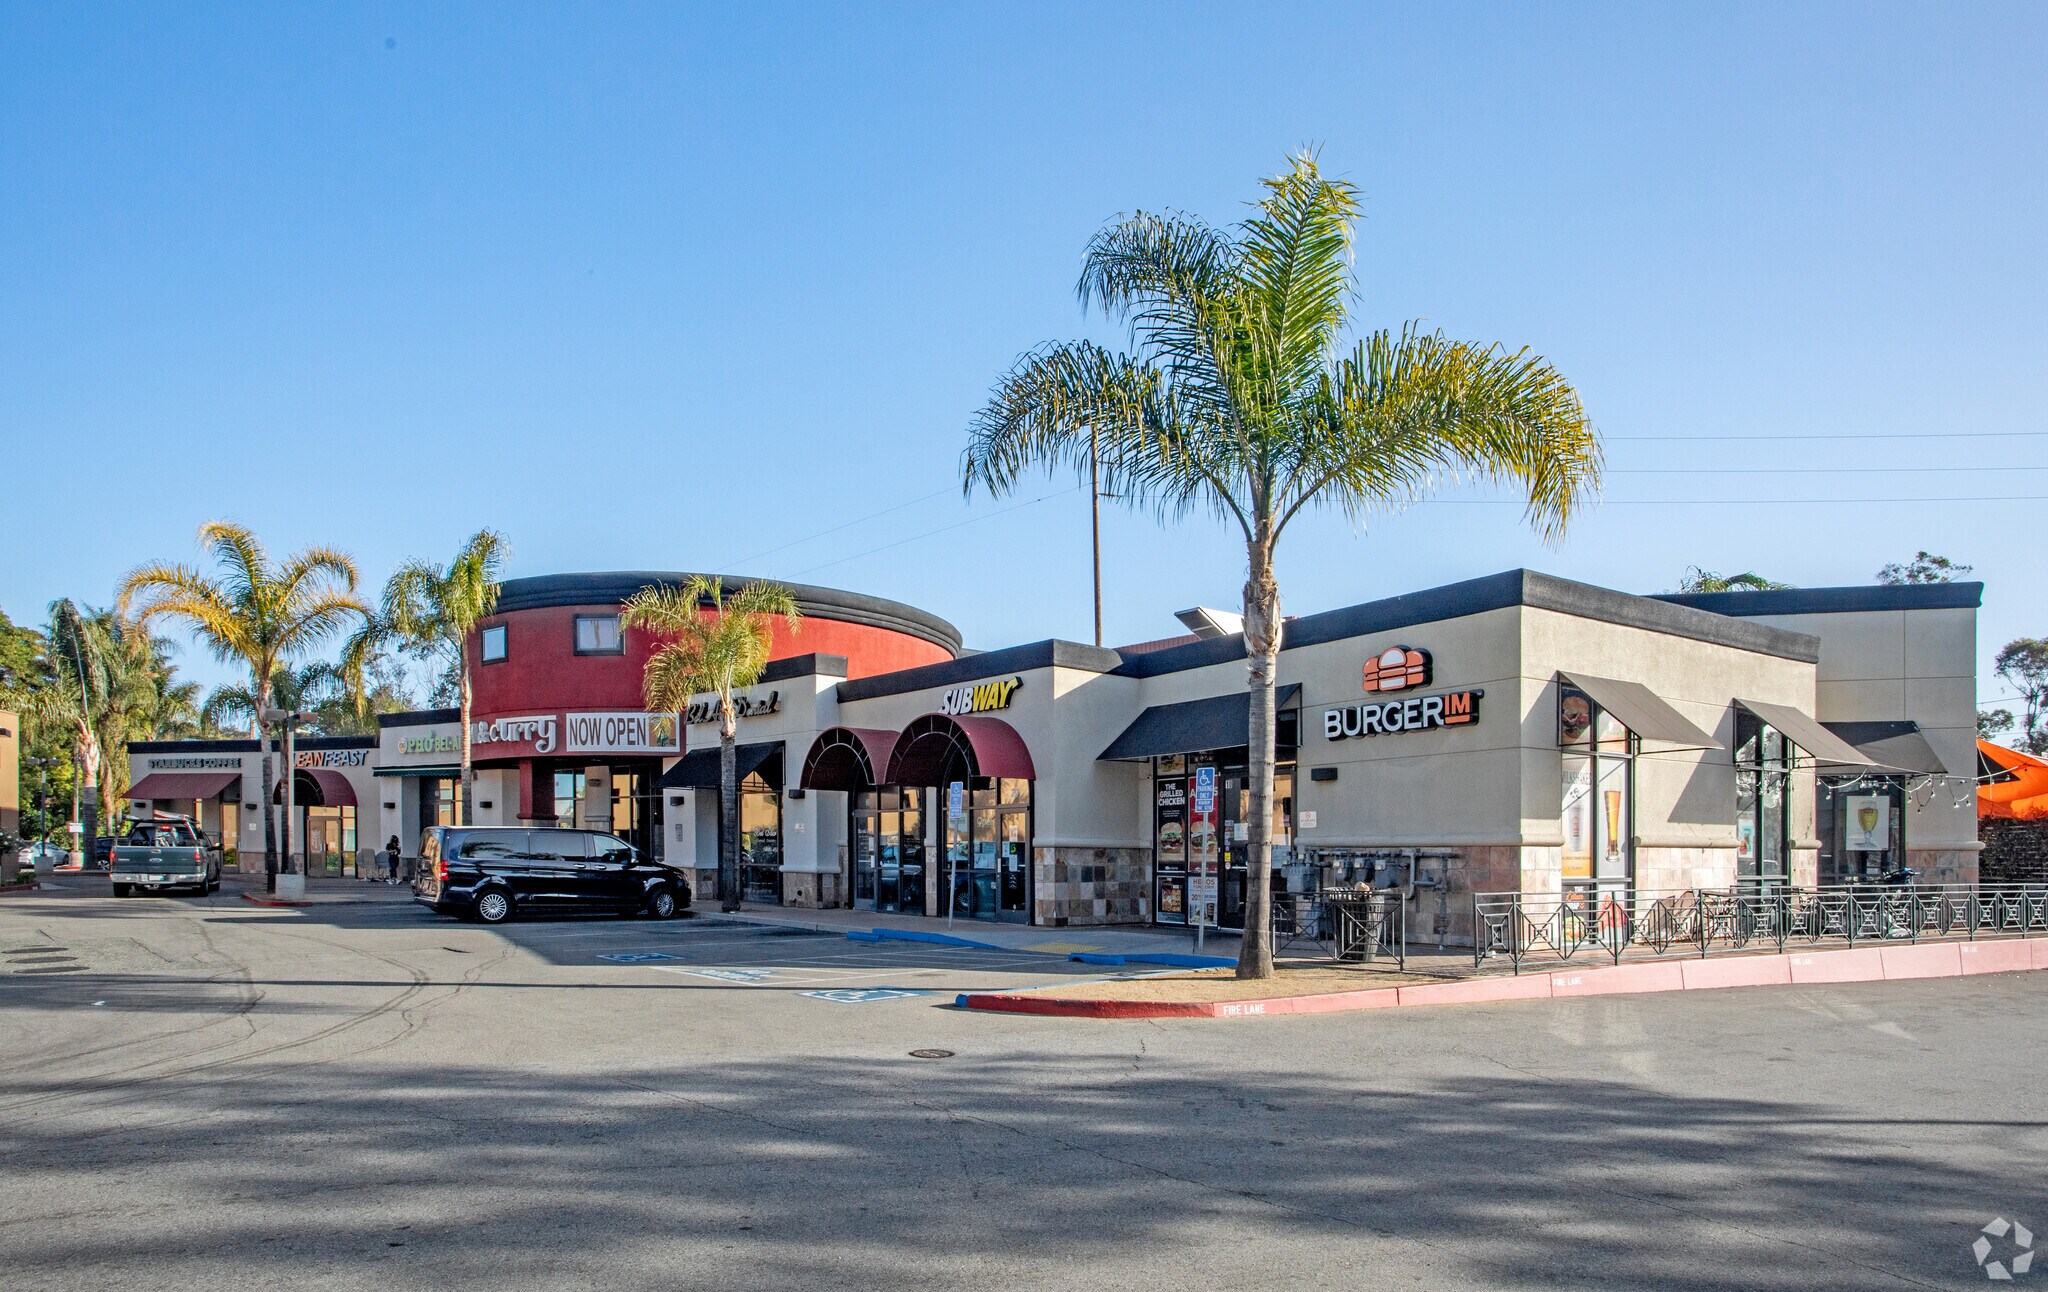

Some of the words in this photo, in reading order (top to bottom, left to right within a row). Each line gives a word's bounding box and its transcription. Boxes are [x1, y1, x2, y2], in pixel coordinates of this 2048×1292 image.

[938, 676, 1019, 715] SUBWAY
[1324, 691, 1472, 739] BURGERIM
[569, 717, 602, 746] NOW
[605, 717, 647, 746] OPEN
[148, 758, 204, 769] STARBUCKS
[203, 758, 242, 768] COFFEE
[1159, 790, 1184, 798] GRILLED
[1158, 797, 1185, 806] CHICKEN
[1223, 1005, 1242, 1015] FIRE
[1244, 1003, 1265, 1014] LANE
